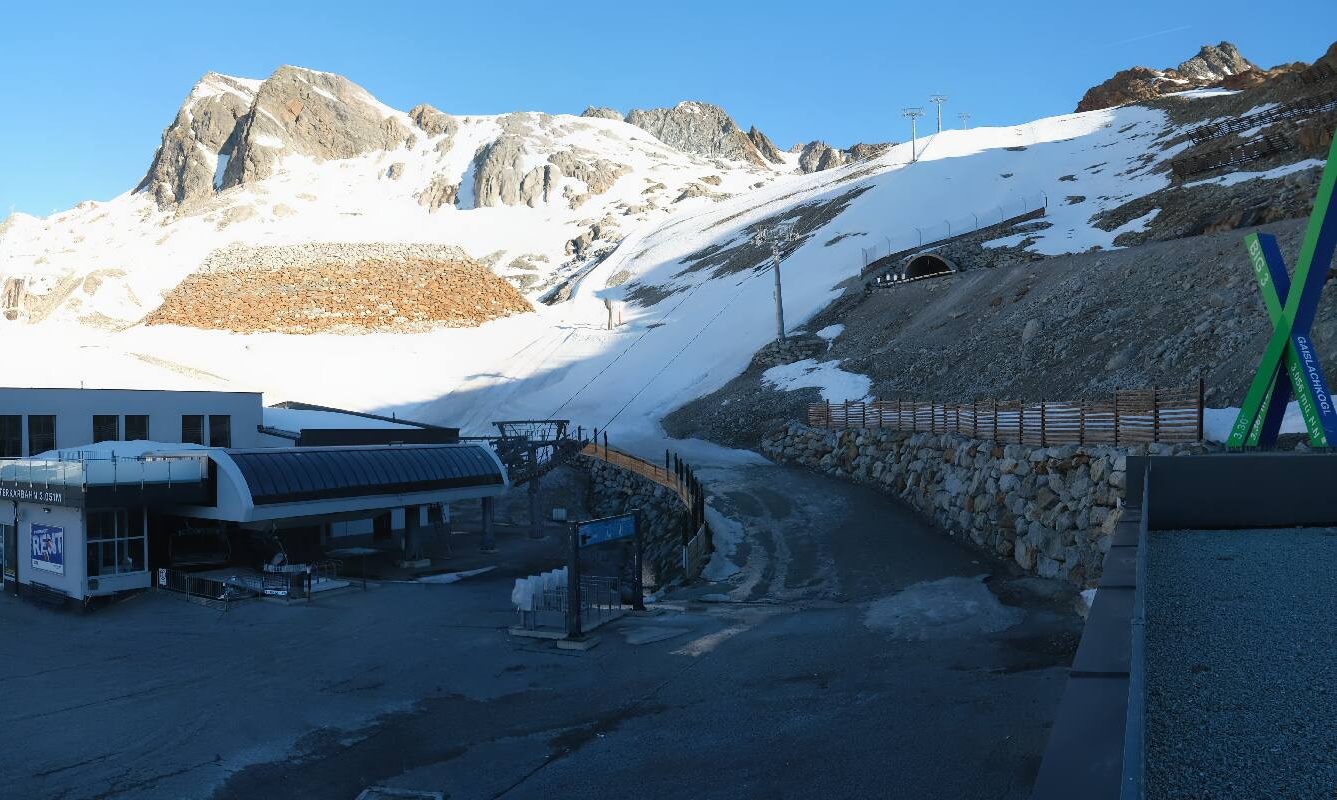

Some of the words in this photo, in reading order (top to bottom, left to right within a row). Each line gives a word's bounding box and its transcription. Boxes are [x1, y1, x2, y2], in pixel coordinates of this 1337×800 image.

[1249, 239, 1265, 272] BIG
[1260, 273, 1269, 286] 3
[1297, 336, 1332, 416] GAISLACHKOGL
[1233, 413, 1248, 440] 3.30
[32, 531, 63, 556] RENT
